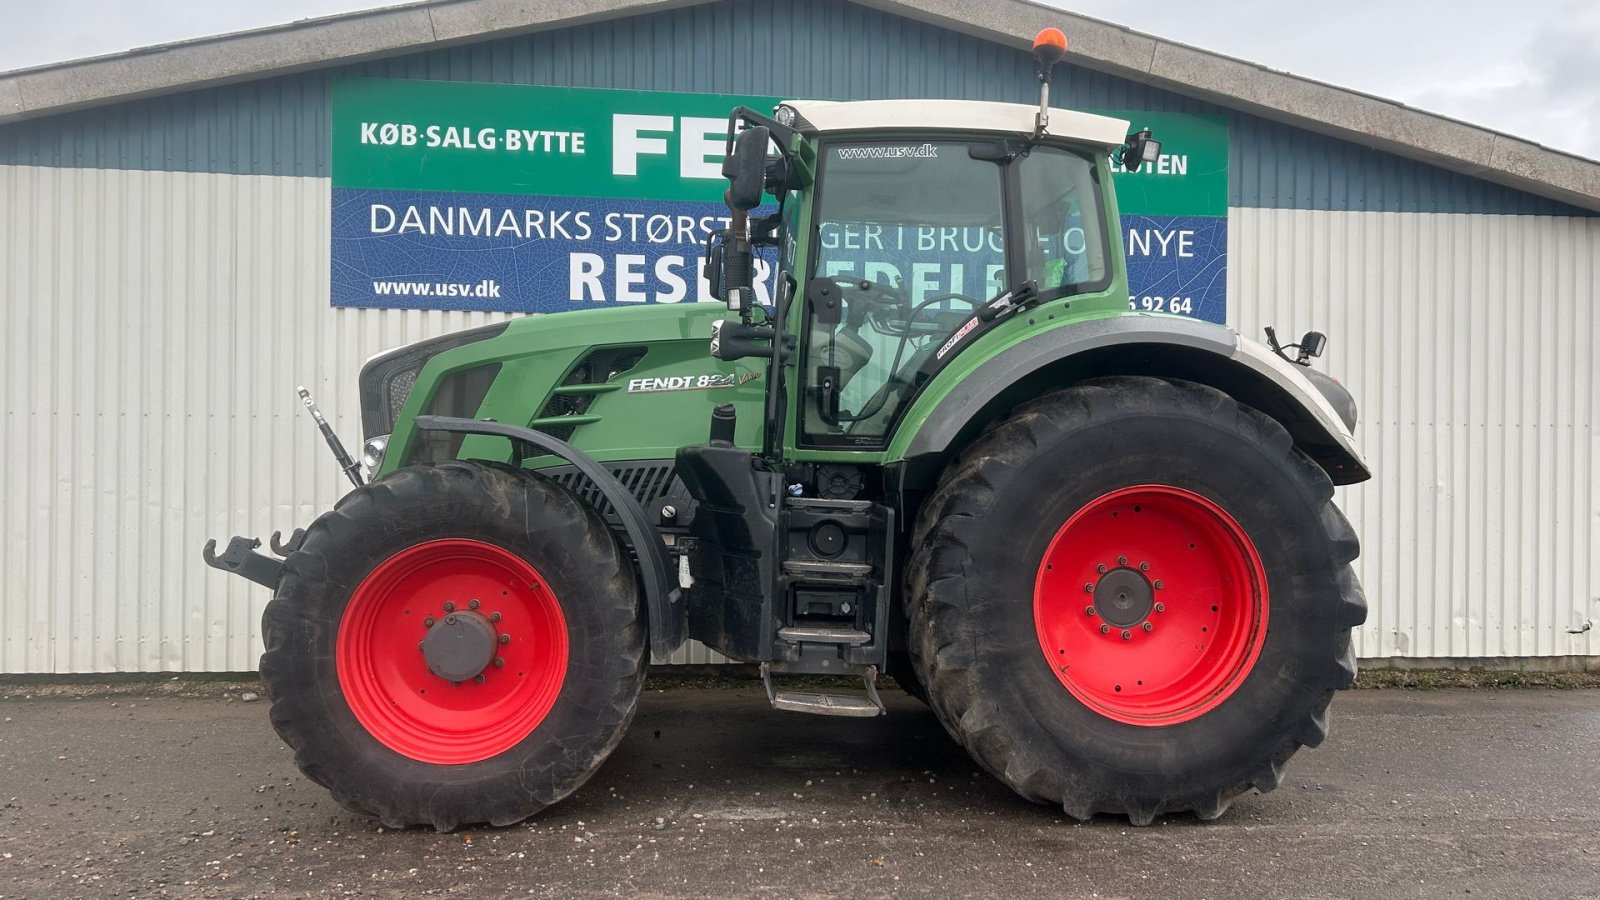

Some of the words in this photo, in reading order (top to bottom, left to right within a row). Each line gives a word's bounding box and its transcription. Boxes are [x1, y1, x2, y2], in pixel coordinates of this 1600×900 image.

[612, 113, 783, 179] FE
[838, 144, 938, 159] www.usv.dk
[370, 204, 592, 241] DANMARKS
[605, 212, 733, 245] STØRST
[820, 222, 883, 250] GER
[1063, 227, 1087, 254] O
[1129, 228, 1194, 257] NYE
[373, 280, 500, 297] www.usv.dk
[1142, 296, 1164, 312] 92
[1170, 297, 1192, 313] 64
[628, 376, 695, 391] FENDT
[697, 373, 735, 387] 824
